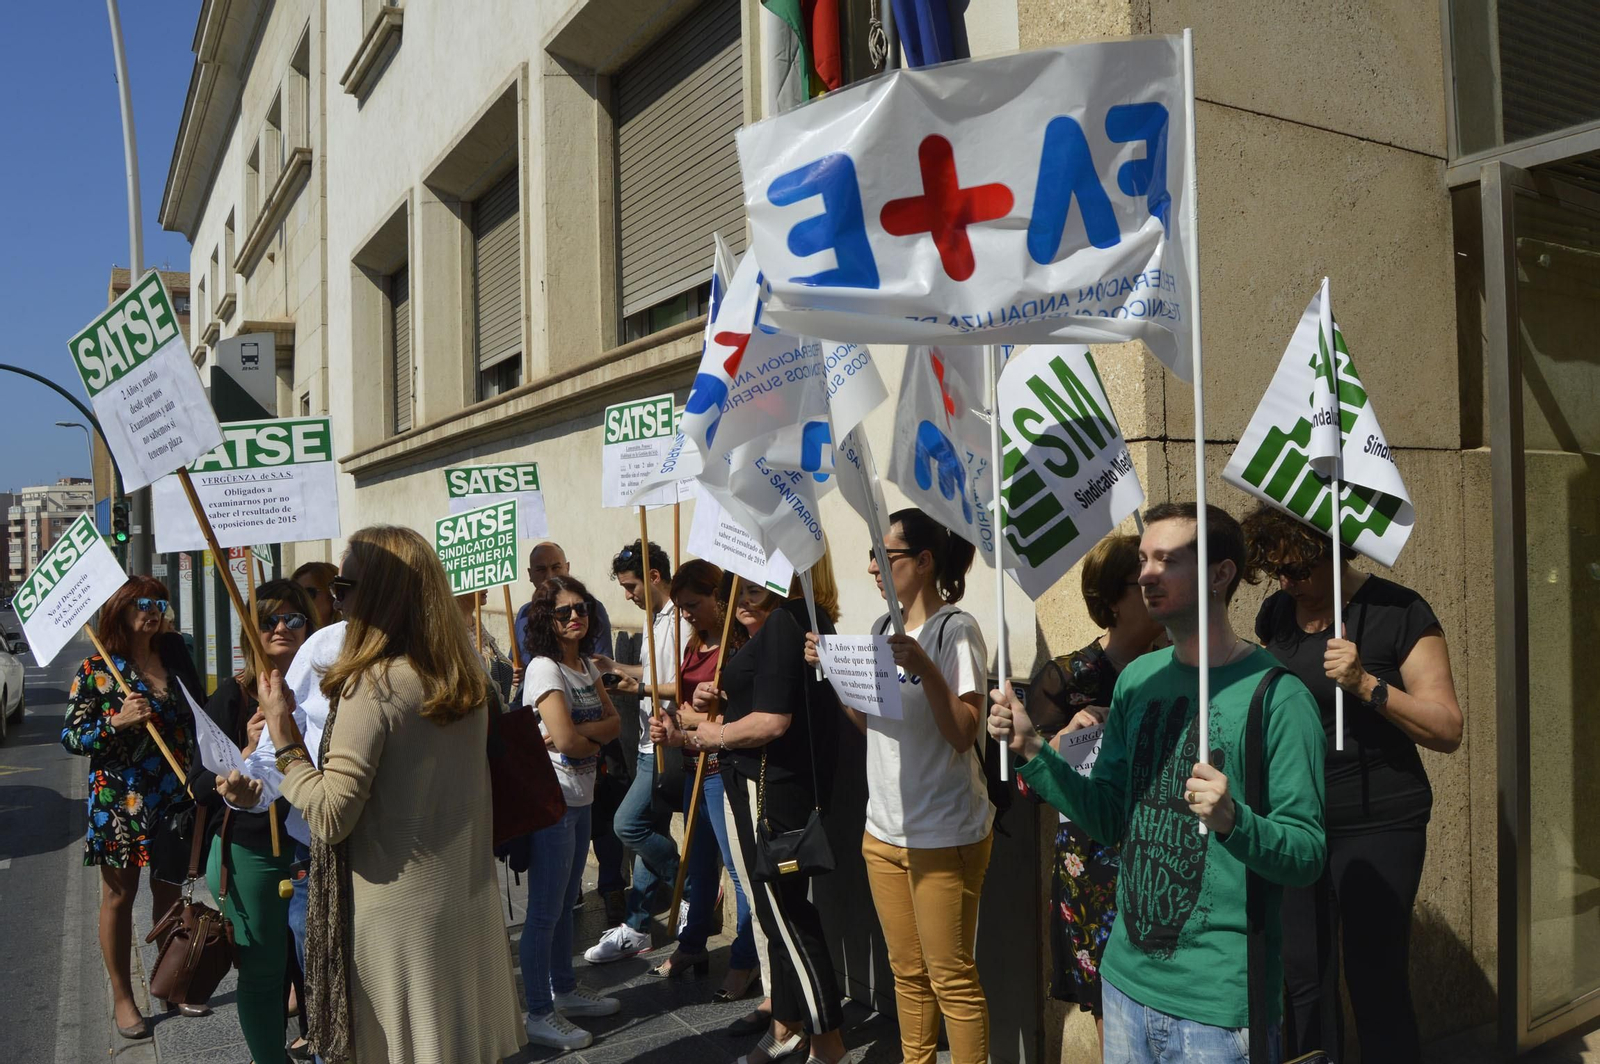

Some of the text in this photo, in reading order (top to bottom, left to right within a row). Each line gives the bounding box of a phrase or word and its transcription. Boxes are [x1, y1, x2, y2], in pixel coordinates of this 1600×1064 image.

[77, 280, 175, 390] SATSE
[121, 390, 127, 400] 2
[127, 382, 140, 398] Años
[143, 370, 159, 388] medio
[130, 389, 163, 415] desde que nos
[129, 409, 161, 433] Examinamos
[165, 400, 175, 414] aún
[606, 401, 671, 442] SATSE
[142, 418, 177, 445] no sabemos si
[148, 435, 183, 460] tenemos plaza
[187, 423, 326, 470] ATSE
[201, 473, 256, 485] VERGÜENZA
[271, 471, 294, 479] S.A.S.
[224, 486, 265, 497] Obligados
[450, 466, 537, 495] SATSE
[1074, 471, 1119, 510] Sindicato
[208, 498, 261, 509] examinarnos
[262, 497, 278, 506] por
[208, 505, 292, 519] saber el resultado de
[770, 472, 823, 542] SANITARIOS
[217, 518, 264, 531] oposiciones
[265, 517, 276, 525] de
[278, 514, 297, 524] 2015
[438, 504, 514, 547] SATSE
[439, 532, 513, 560] SINDICATO DE
[718, 530, 731, 541] saber
[736, 539, 759, 553] resultado
[721, 542, 747, 559] oposiciones
[747, 553, 754, 562] de
[753, 555, 766, 567] 2015
[18, 519, 96, 618] SATSE
[451, 559, 514, 592] LMERÍA
[47, 609, 58, 620] No
[62, 573, 88, 604] Desprecio
[54, 613, 63, 625] del
[81, 584, 91, 594] los
[62, 597, 92, 629] Opositores
[829, 643, 878, 654] 2 Años y medio
[833, 655, 850, 664] desde
[852, 658, 865, 666] que
[829, 666, 868, 677] Examinamos
[875, 670, 889, 678] aún
[848, 680, 874, 690] sabemos
[875, 682, 881, 691] si
[844, 691, 884, 703] tenemos plaza
[1069, 729, 1105, 745] VERGÜ
